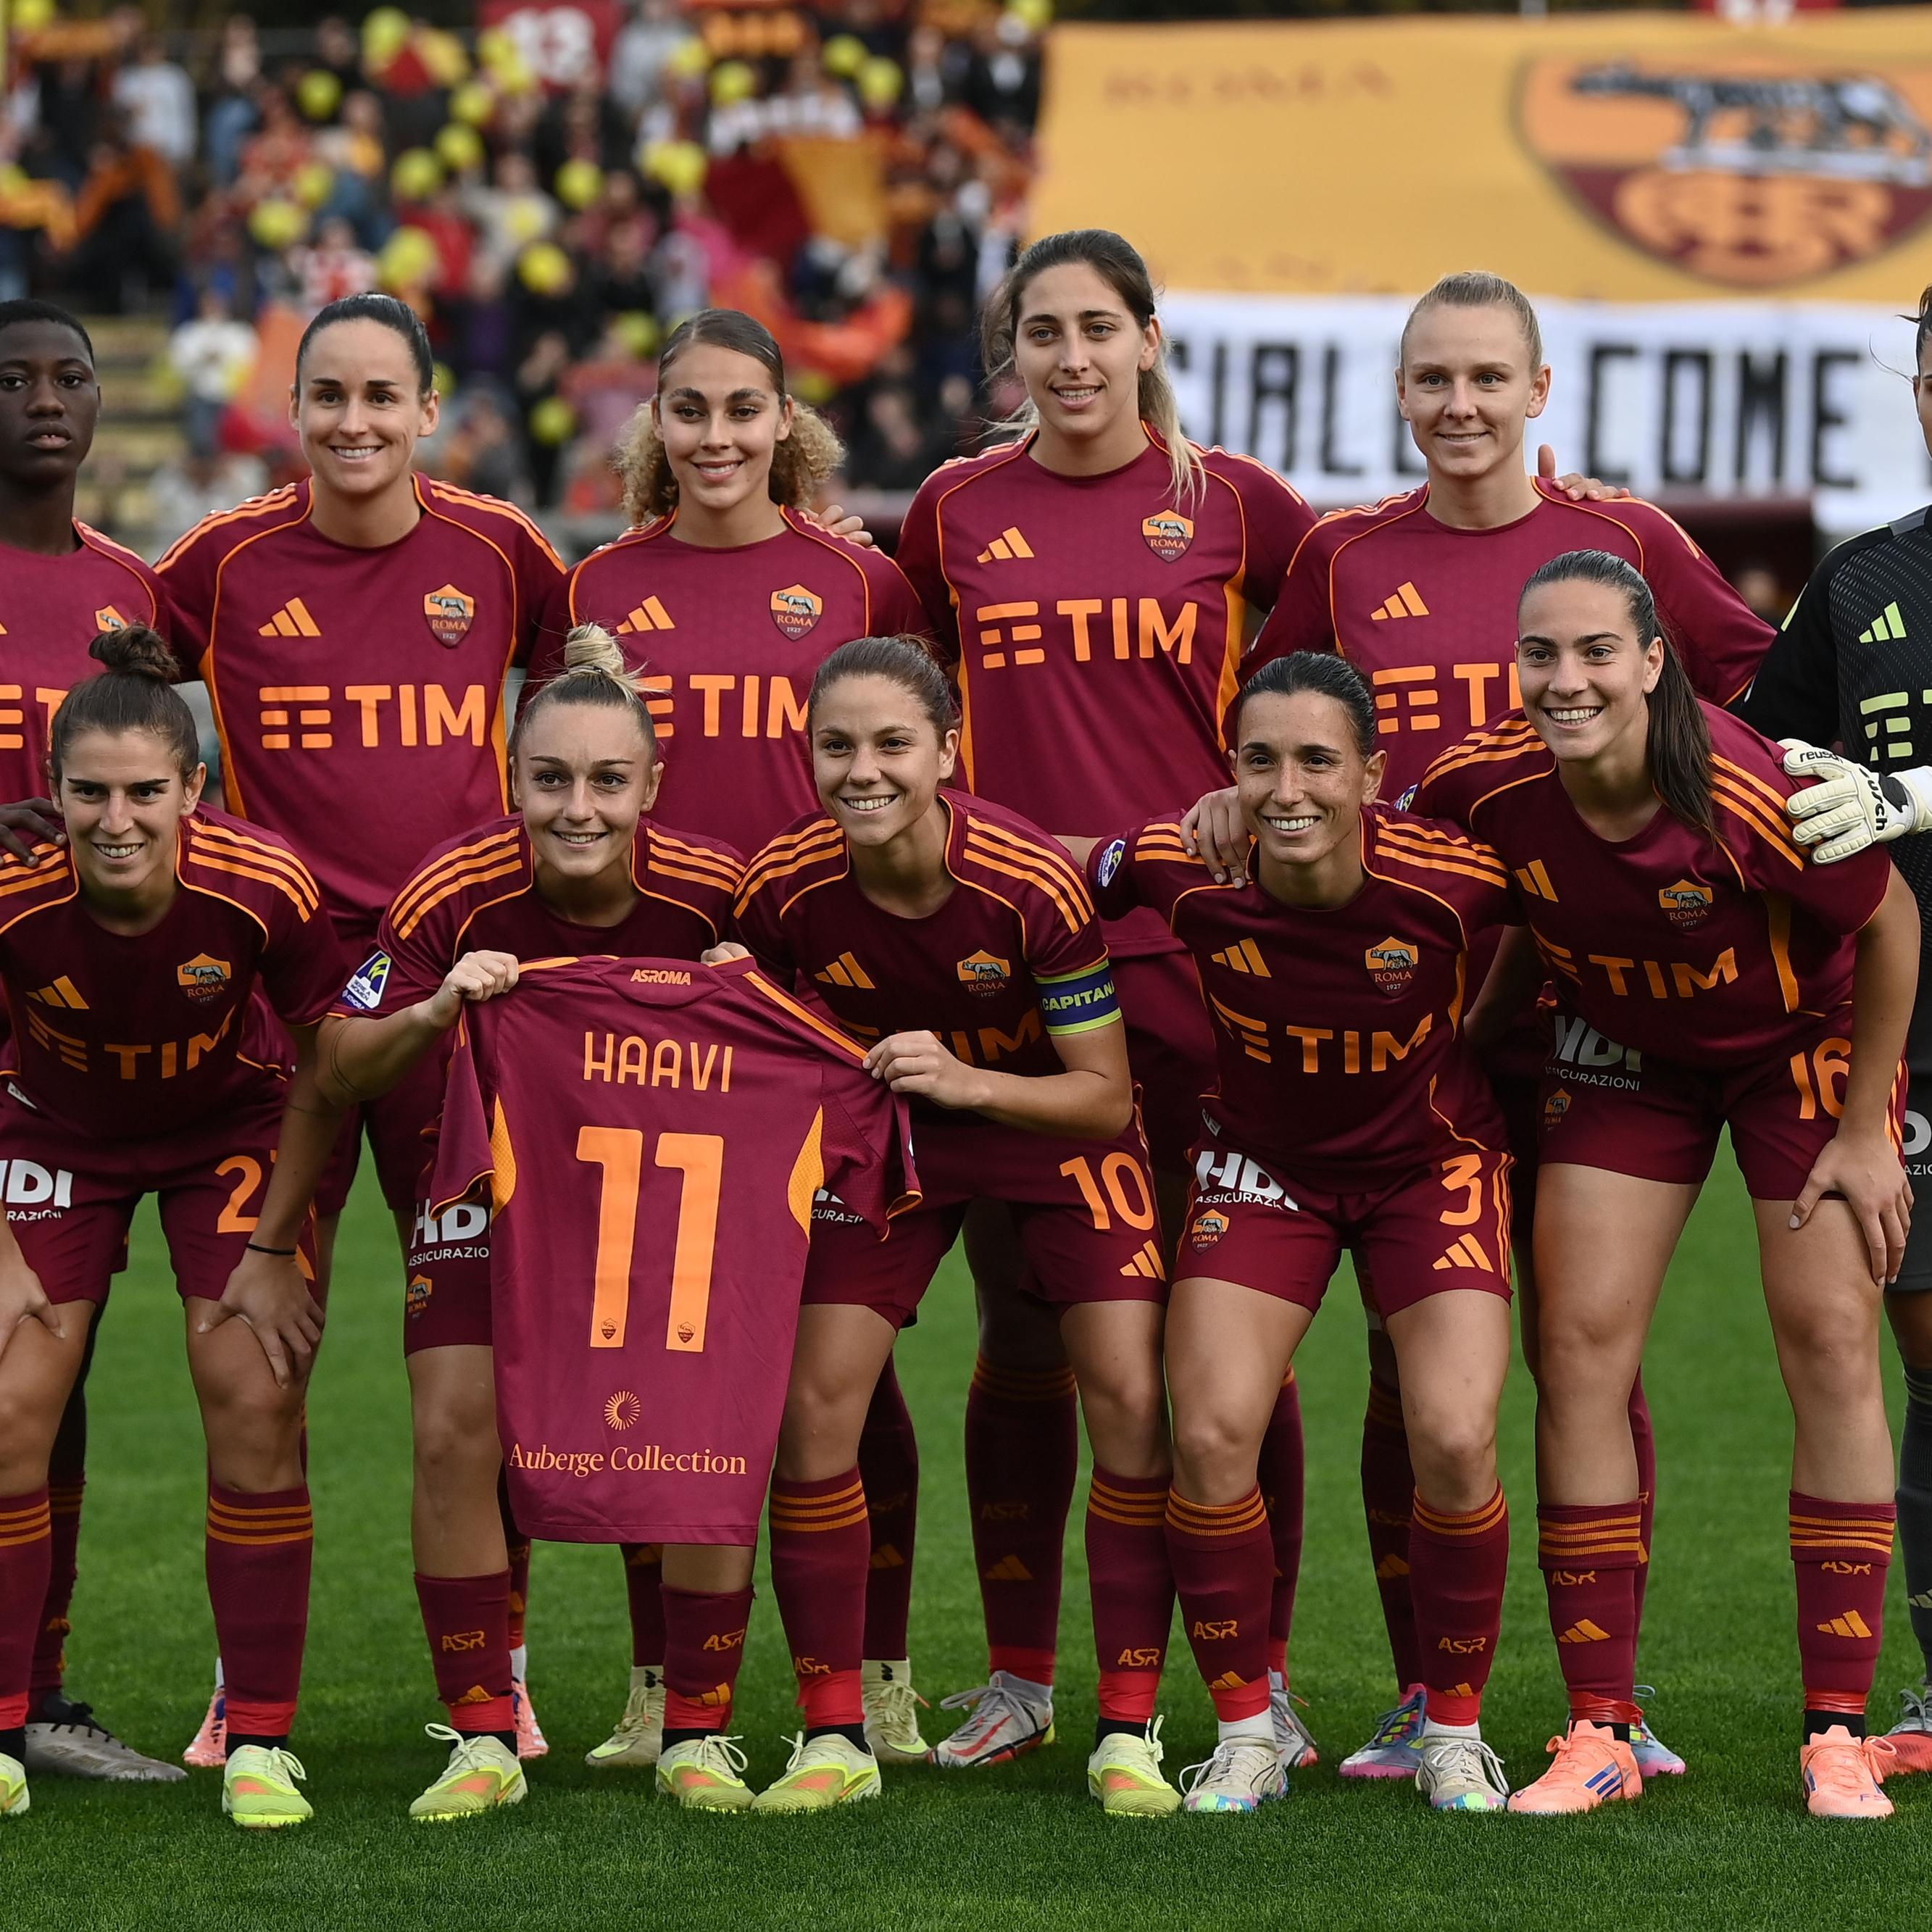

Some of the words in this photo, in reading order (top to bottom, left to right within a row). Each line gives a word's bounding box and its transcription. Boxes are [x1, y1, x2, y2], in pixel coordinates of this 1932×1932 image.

[1586, 343, 1860, 488] COME
[1150, 538, 1186, 550] ROMA
[431, 619, 468, 631] ROMA
[776, 615, 813, 628] ROMA
[1056, 597, 1199, 665] TIM
[1453, 662, 1524, 728] TI
[344, 683, 486, 748] TIM
[1669, 909, 1708, 921] ROMA
[1374, 970, 1412, 983] ROMA
[1587, 946, 1739, 999] TIM
[187, 984, 225, 998] ROMA
[967, 981, 1006, 992] ROMA
[1286, 1012, 1433, 1074] TIM
[583, 1030, 733, 1093] HAAVI
[1059, 1152, 1154, 1231] 10
[1438, 1153, 1483, 1226] 3
[575, 1126, 725, 1354] 11
[1192, 1233, 1219, 1244] ROMA
[508, 1443, 604, 1478] Auberge
[610, 1445, 747, 1475] Collection
[1193, 1620, 1238, 1639] ASR
[441, 1630, 486, 1652] ASR
[1438, 1636, 1486, 1654] ASR
[1117, 1647, 1160, 1667] ASR
